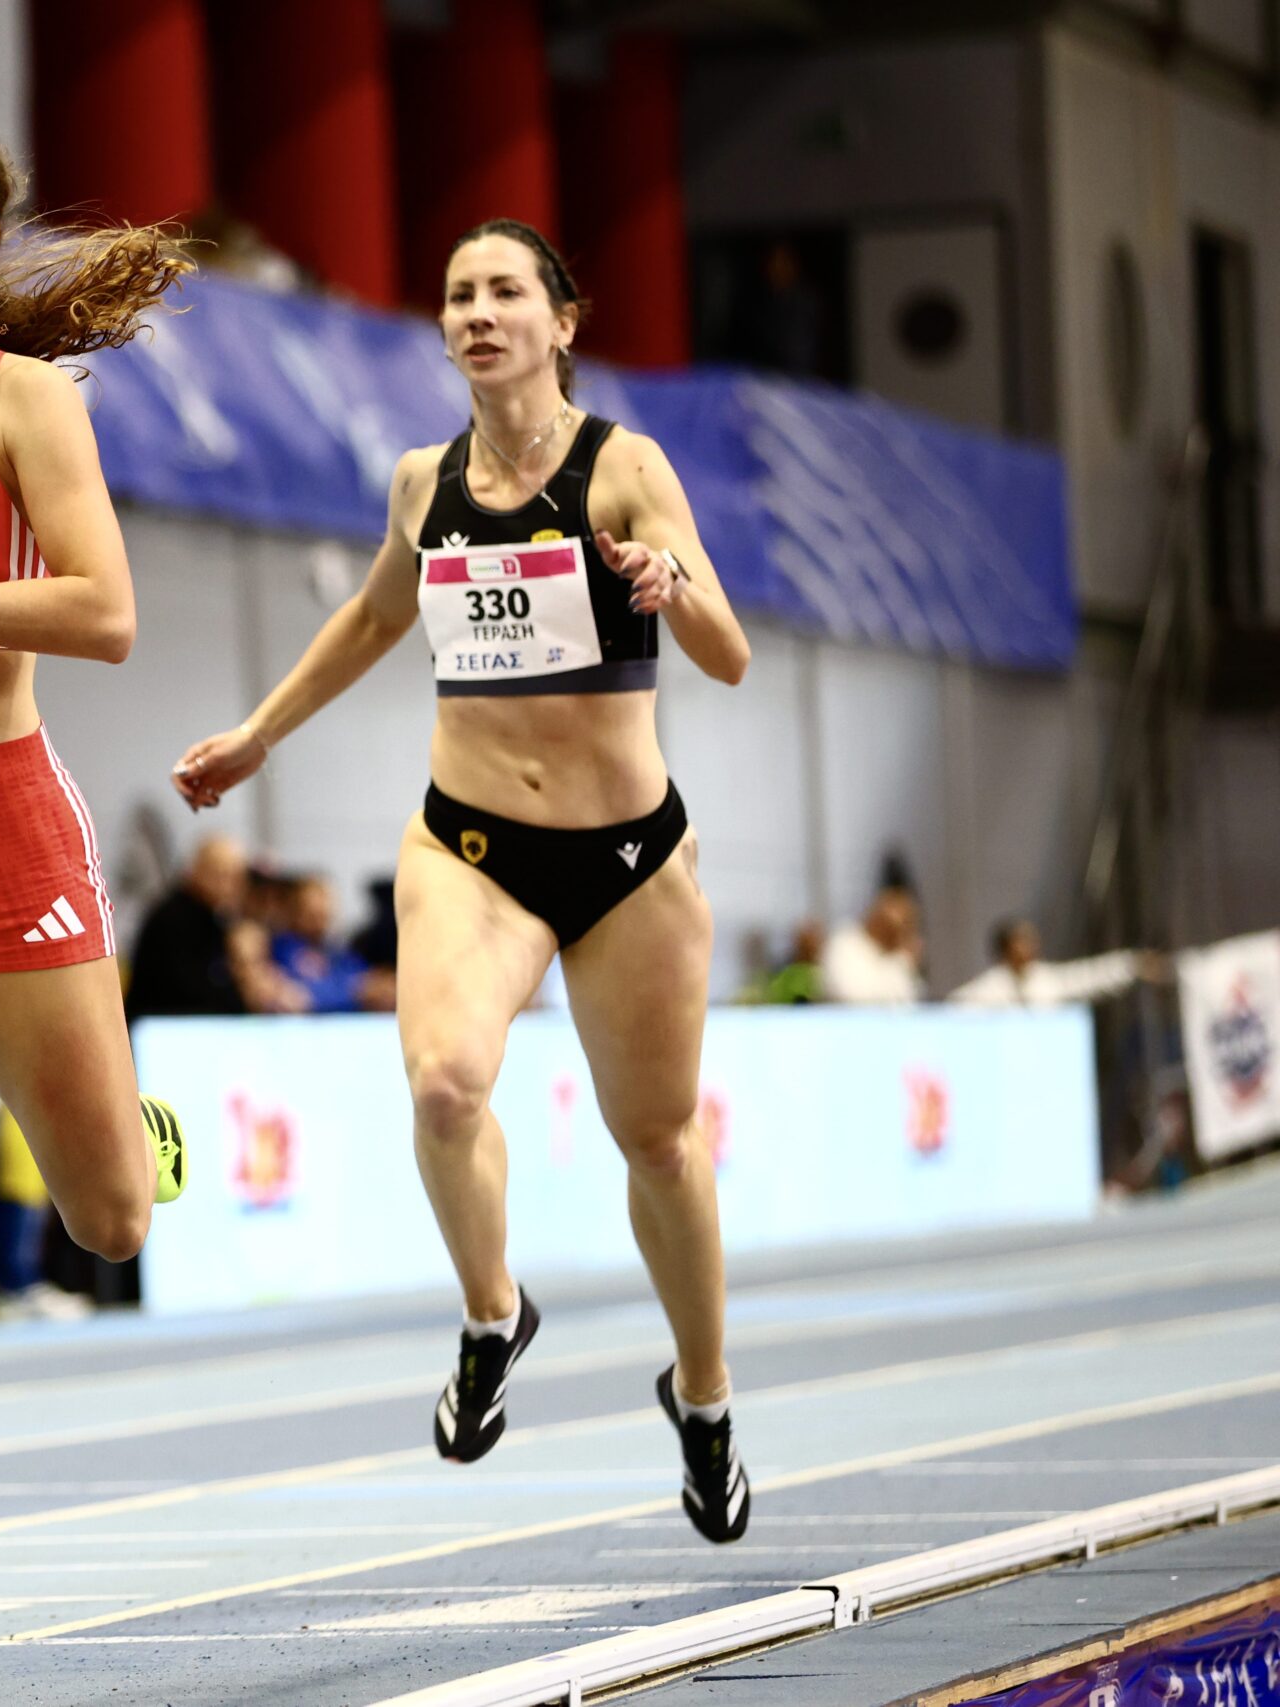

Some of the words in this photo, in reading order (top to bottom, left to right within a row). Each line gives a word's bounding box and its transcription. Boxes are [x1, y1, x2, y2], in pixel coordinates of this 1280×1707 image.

[465, 587, 530, 621] 330
[473, 622, 535, 641] ΓΕΡΑΣΗ
[456, 651, 523, 671] ΣΕΓΑΣ
